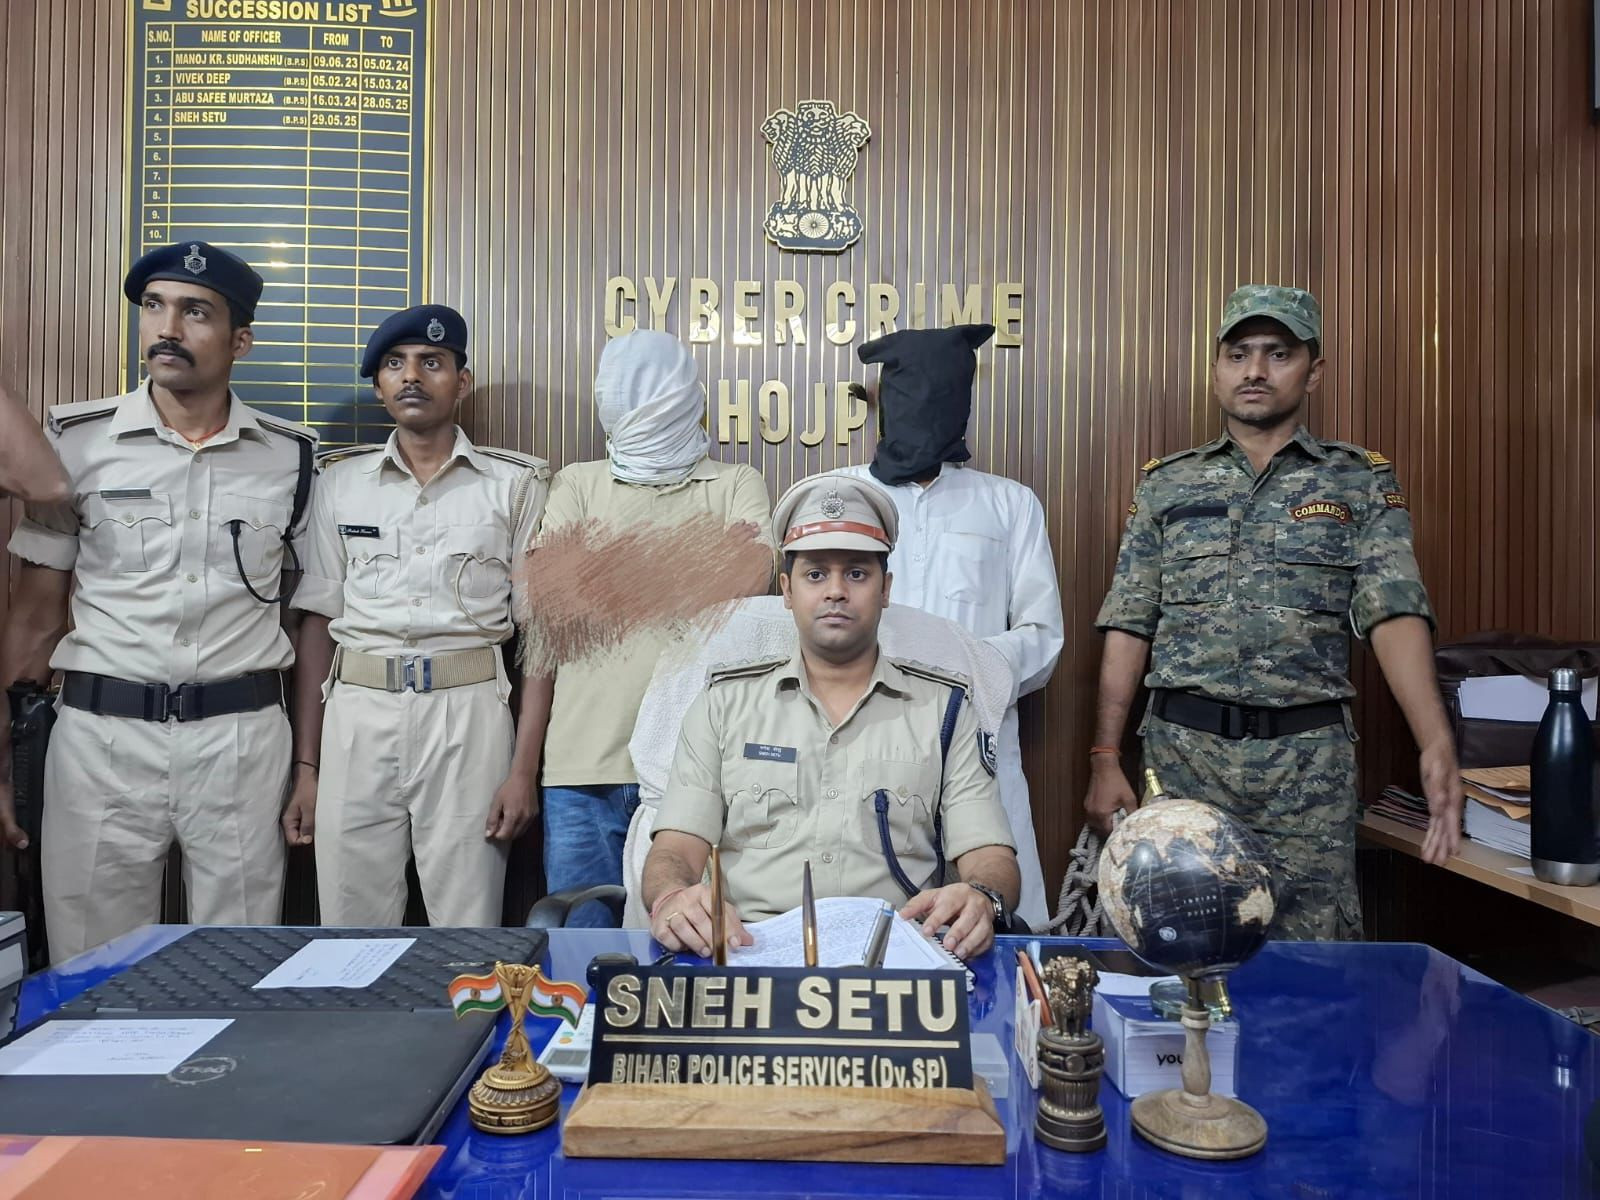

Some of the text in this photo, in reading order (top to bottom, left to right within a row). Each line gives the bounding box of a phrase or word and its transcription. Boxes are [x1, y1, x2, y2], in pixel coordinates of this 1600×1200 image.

[186, 0, 372, 23] SUCCESSION LIST
[148, 30, 393, 48] S.NO. NAME OF OFFICER FROM TO
[155, 55, 163, 64] 1.
[175, 54, 207, 65] MANOJ
[209, 54, 225, 65] KR.
[226, 54, 283, 66] SUDHANSHU
[154, 74, 163, 83] 2.
[175, 73, 204, 84] VIVEK
[206, 73, 231, 84] DEEP
[154, 93, 162, 102] 3.
[175, 92, 195, 103] ABU
[197, 92, 227, 103] SAFEE
[228, 92, 275, 104] MURTAZA
[153, 113, 162, 122] 4.
[174, 112, 200, 123] SNEH
[202, 112, 227, 123] SETU
[153, 132, 162, 141] 5.
[153, 152, 161, 161] 6.
[152, 171, 161, 180] 7.
[152, 191, 160, 200] 8.
[152, 210, 160, 219] 9.
[149, 230, 162, 239] 10.
[604, 276, 1024, 346] CYBER CRIME
[700, 379, 868, 446] HOJP
[1295, 503, 1345, 520] COMMANDO
[604, 974, 957, 1033] SNEH SETU
[612, 1053, 681, 1085] BIHAR
[687, 1054, 766, 1086] POLICE
[772, 1055, 865, 1088] SERVICE
